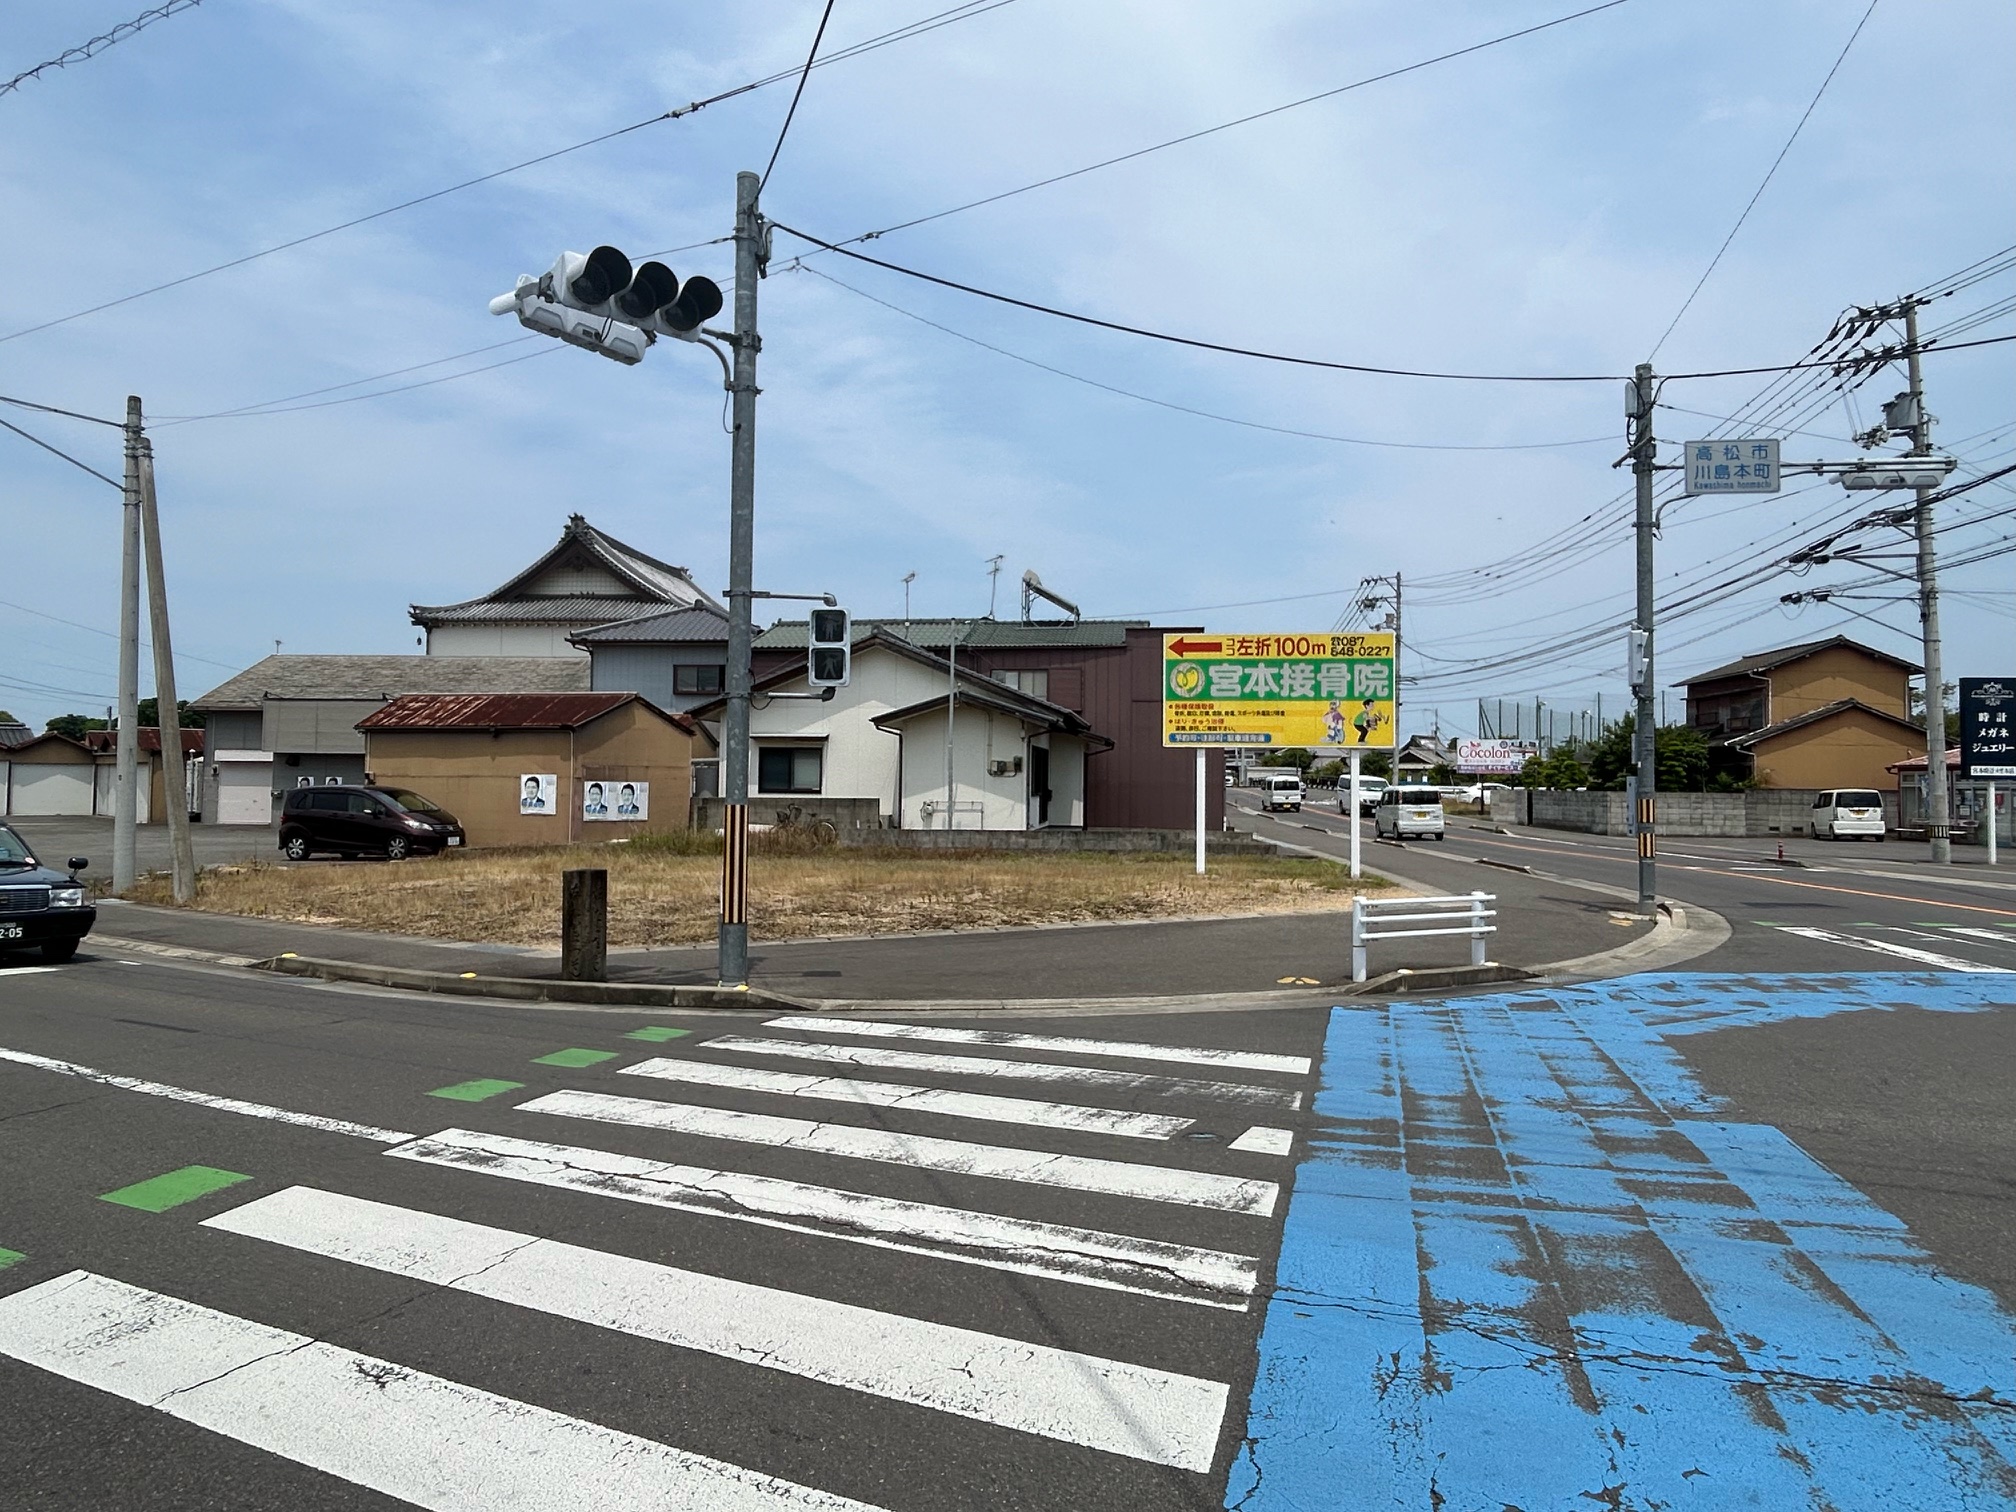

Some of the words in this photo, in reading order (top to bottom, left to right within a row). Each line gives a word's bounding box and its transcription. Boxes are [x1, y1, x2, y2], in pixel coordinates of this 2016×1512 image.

[1696, 444, 1768, 461] 高松市
[1695, 463, 1770, 479] 川島本町
[1694, 482, 1733, 490] Kawashima
[1738, 481, 1771, 489] honmachi
[1209, 663, 1389, 698] 宮本接骨院
[1978, 712, 2007, 723] 時計
[1978, 728, 2009, 738] メガネ
[1459, 745, 1511, 759] Cocolon
[1972, 743, 2015, 752] ジュエリー
